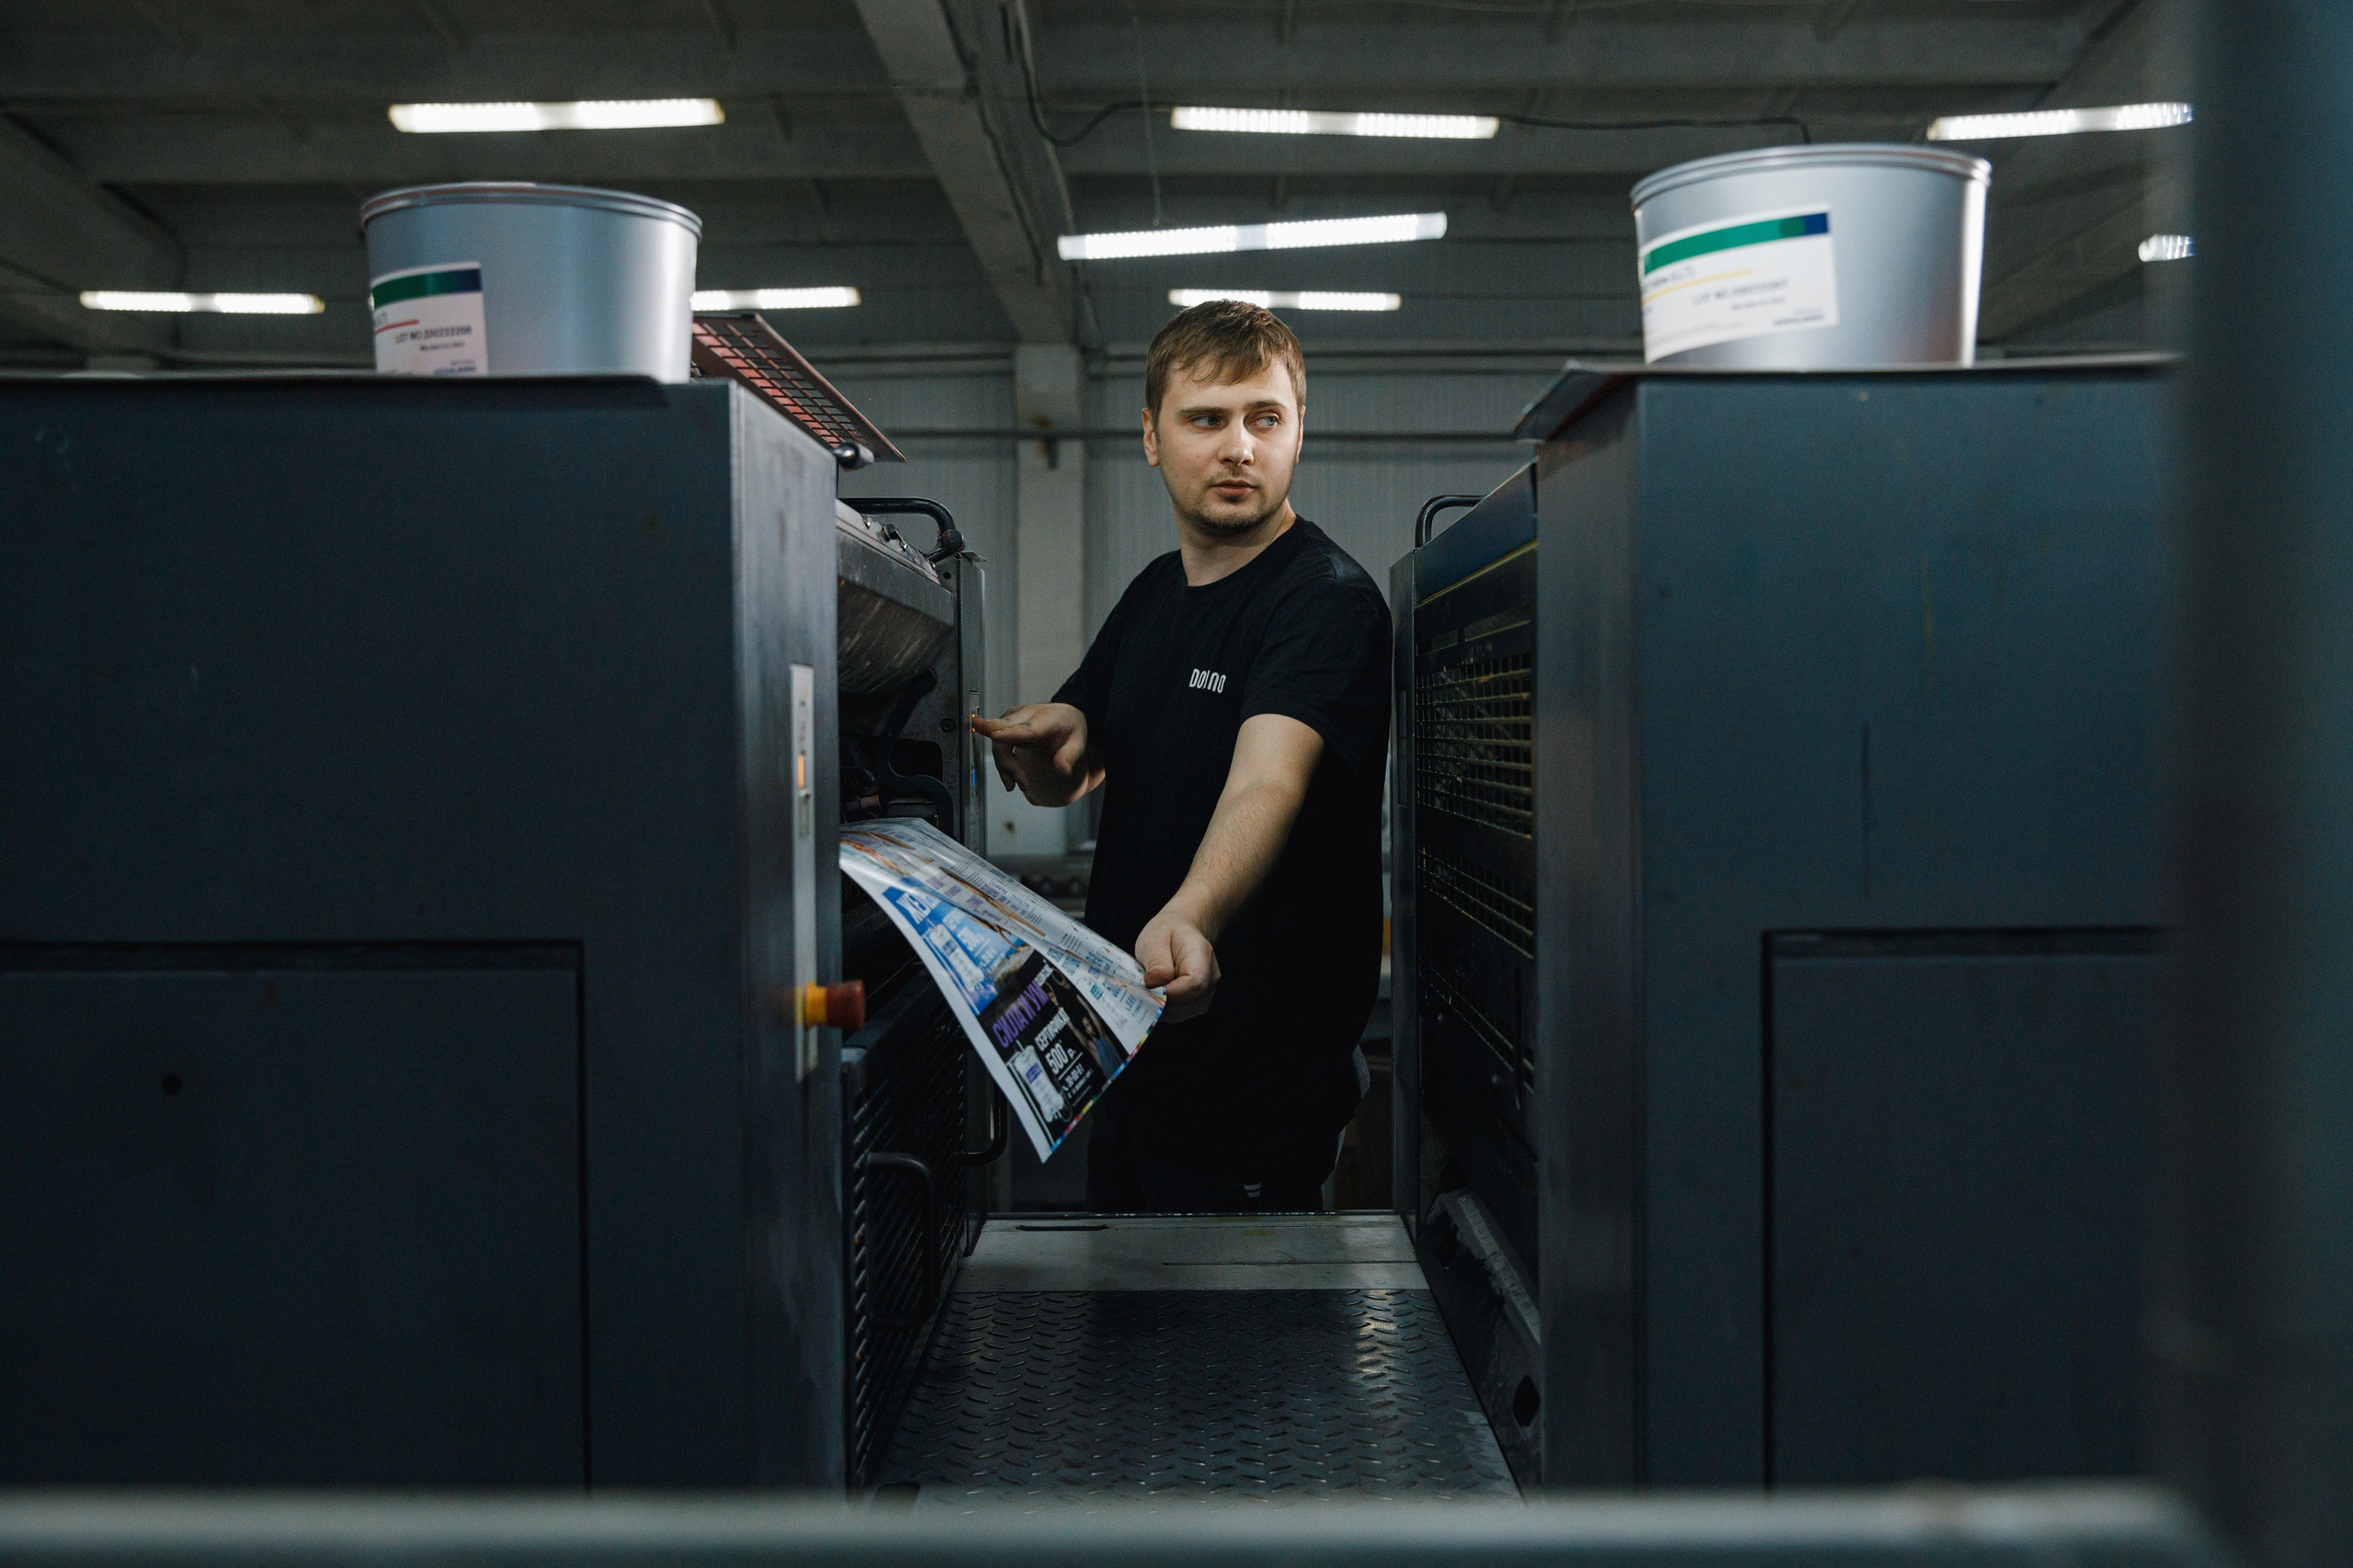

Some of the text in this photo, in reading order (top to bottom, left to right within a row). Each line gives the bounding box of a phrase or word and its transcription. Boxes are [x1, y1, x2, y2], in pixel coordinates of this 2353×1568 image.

[1017, 994, 1038, 1021] И
[1022, 980, 1049, 1012] УМ
[992, 1003, 1029, 1049] СИЛА
[1034, 1007, 1071, 1051] СЕРТИФИКАТ
